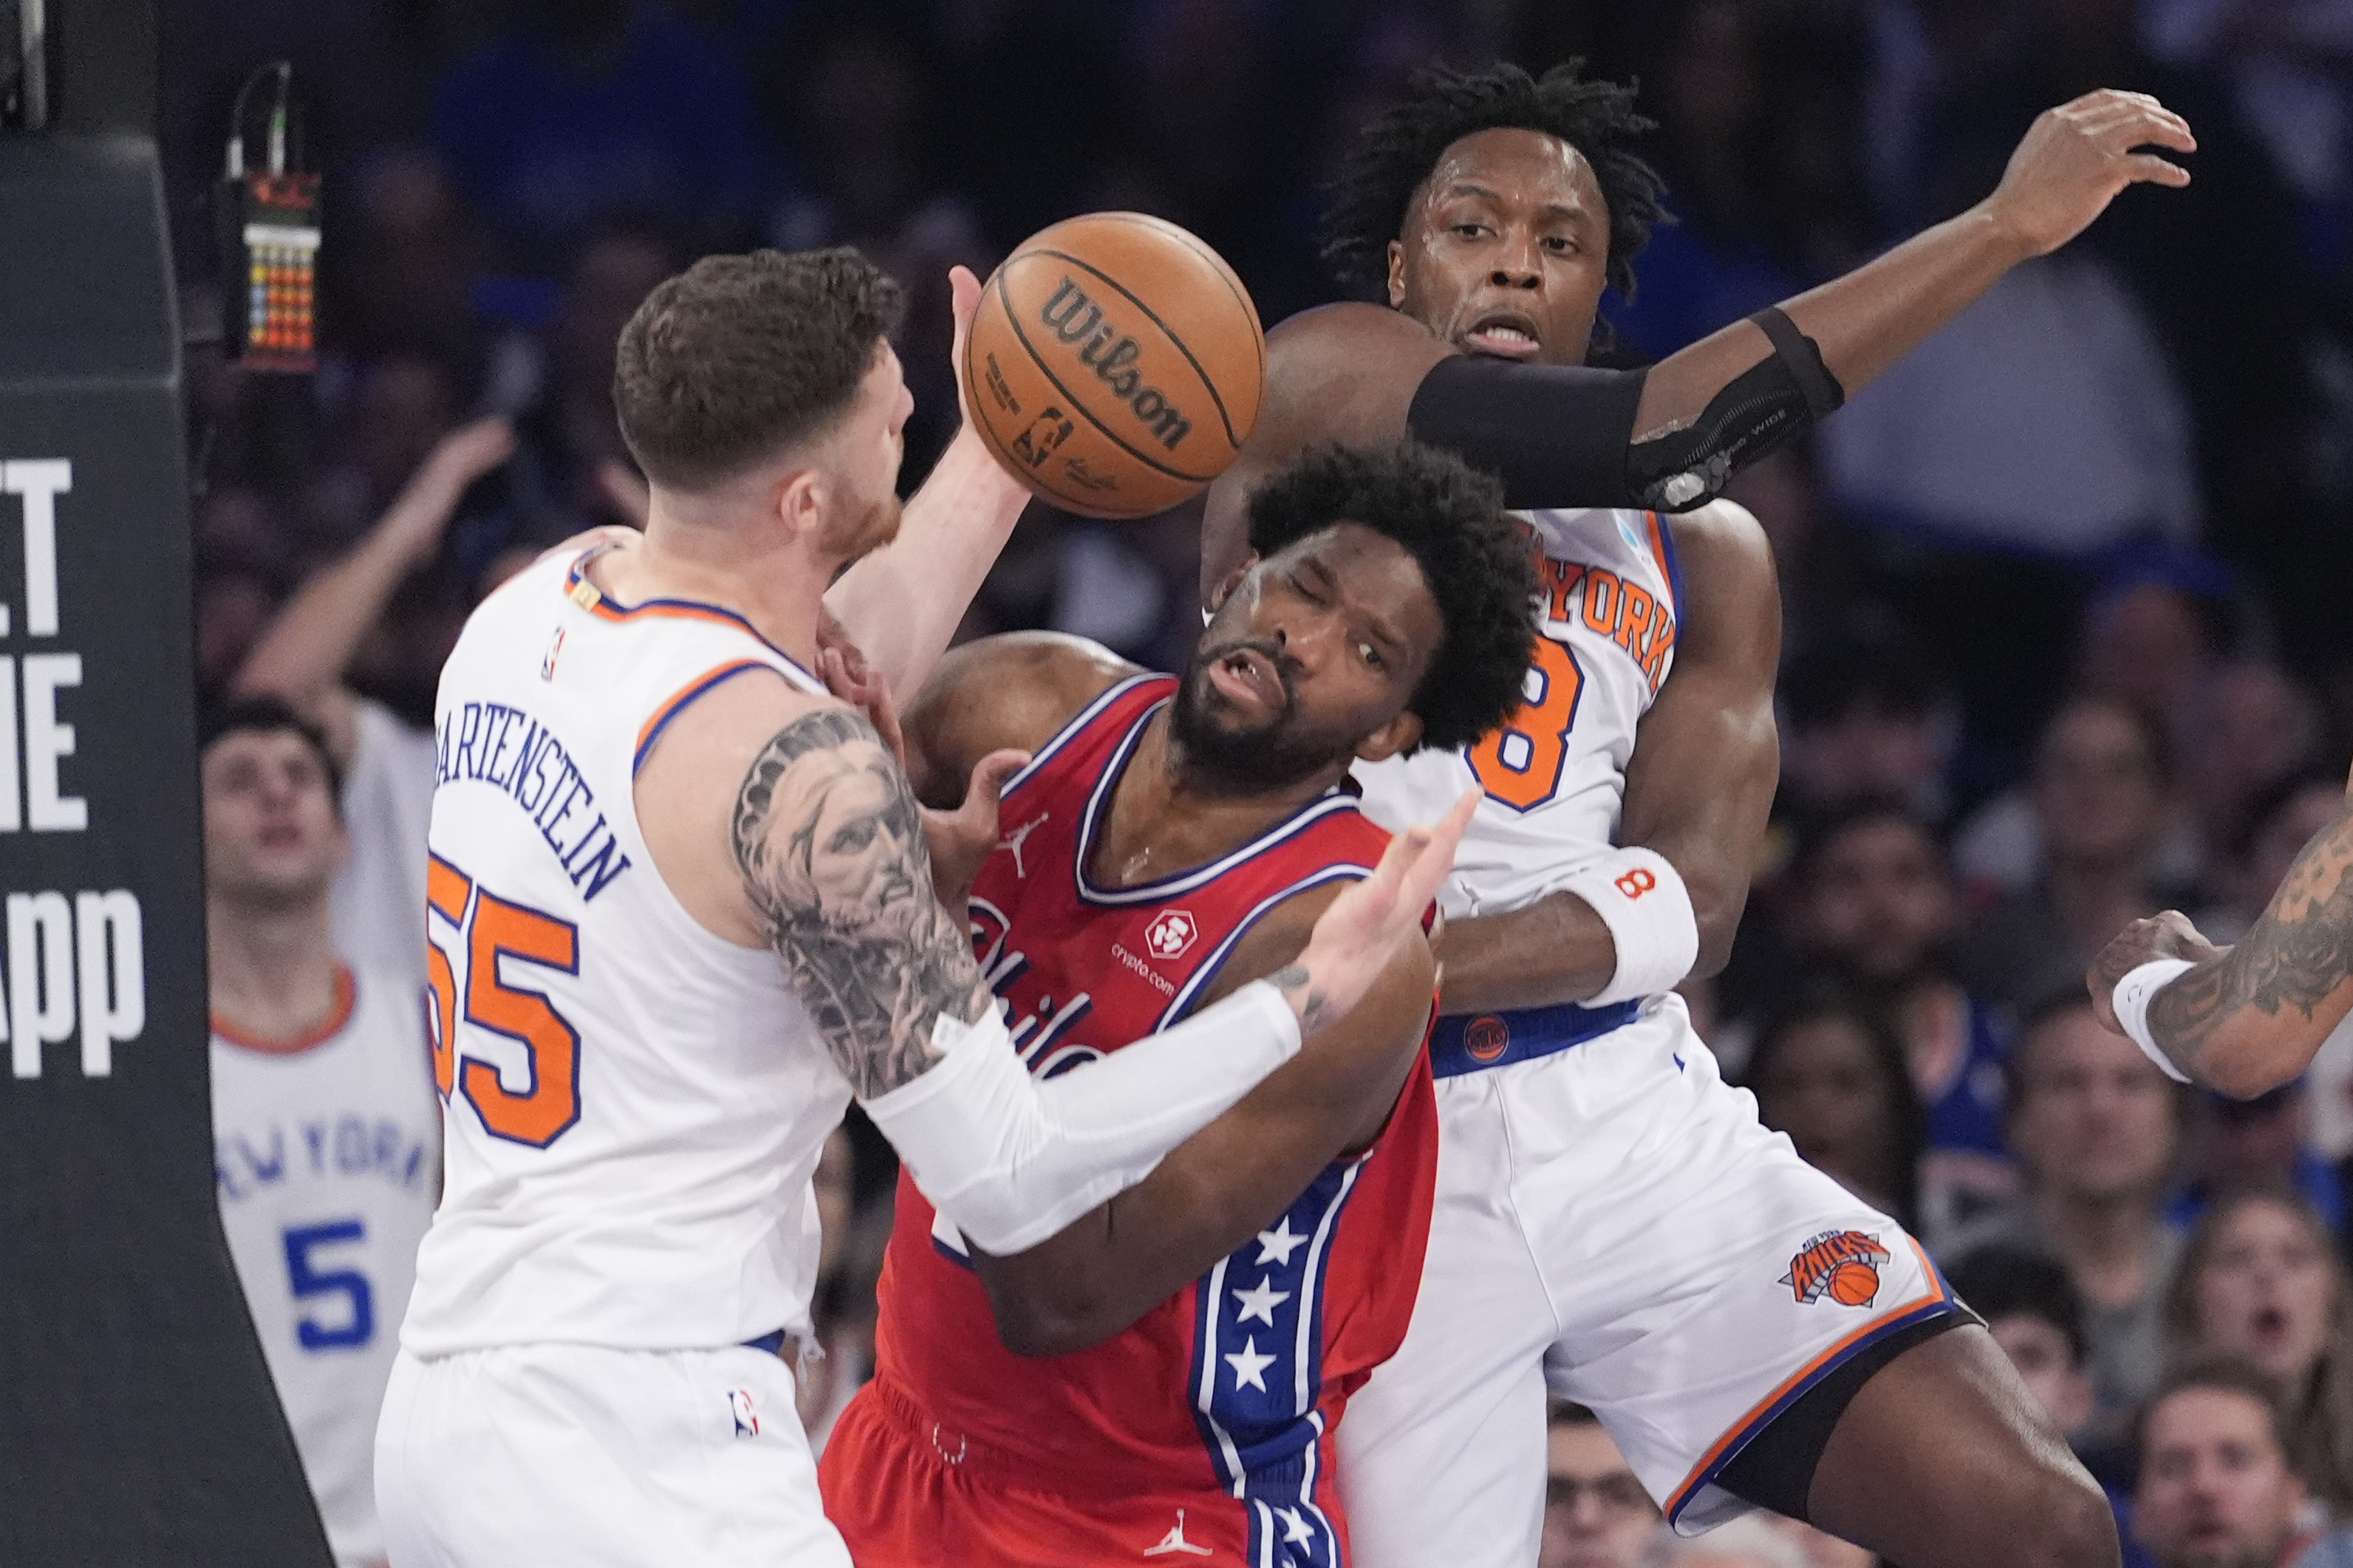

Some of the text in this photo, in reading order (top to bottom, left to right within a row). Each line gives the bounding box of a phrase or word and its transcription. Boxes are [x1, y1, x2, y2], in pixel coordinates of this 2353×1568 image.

[1040, 274, 1192, 451] Wilson
[0, 456, 72, 638] T
[1544, 556, 1676, 698] YORK
[0, 652, 89, 832] E
[434, 701, 634, 904] ARTENSTEIN
[1464, 629, 1585, 813] 8
[1111, 942, 1175, 998] crypto.com
[1614, 868, 1656, 900] 8
[0, 888, 146, 1079] pp
[281, 1217, 375, 1354] 5
[1790, 1230, 1891, 1303] KNICKS
